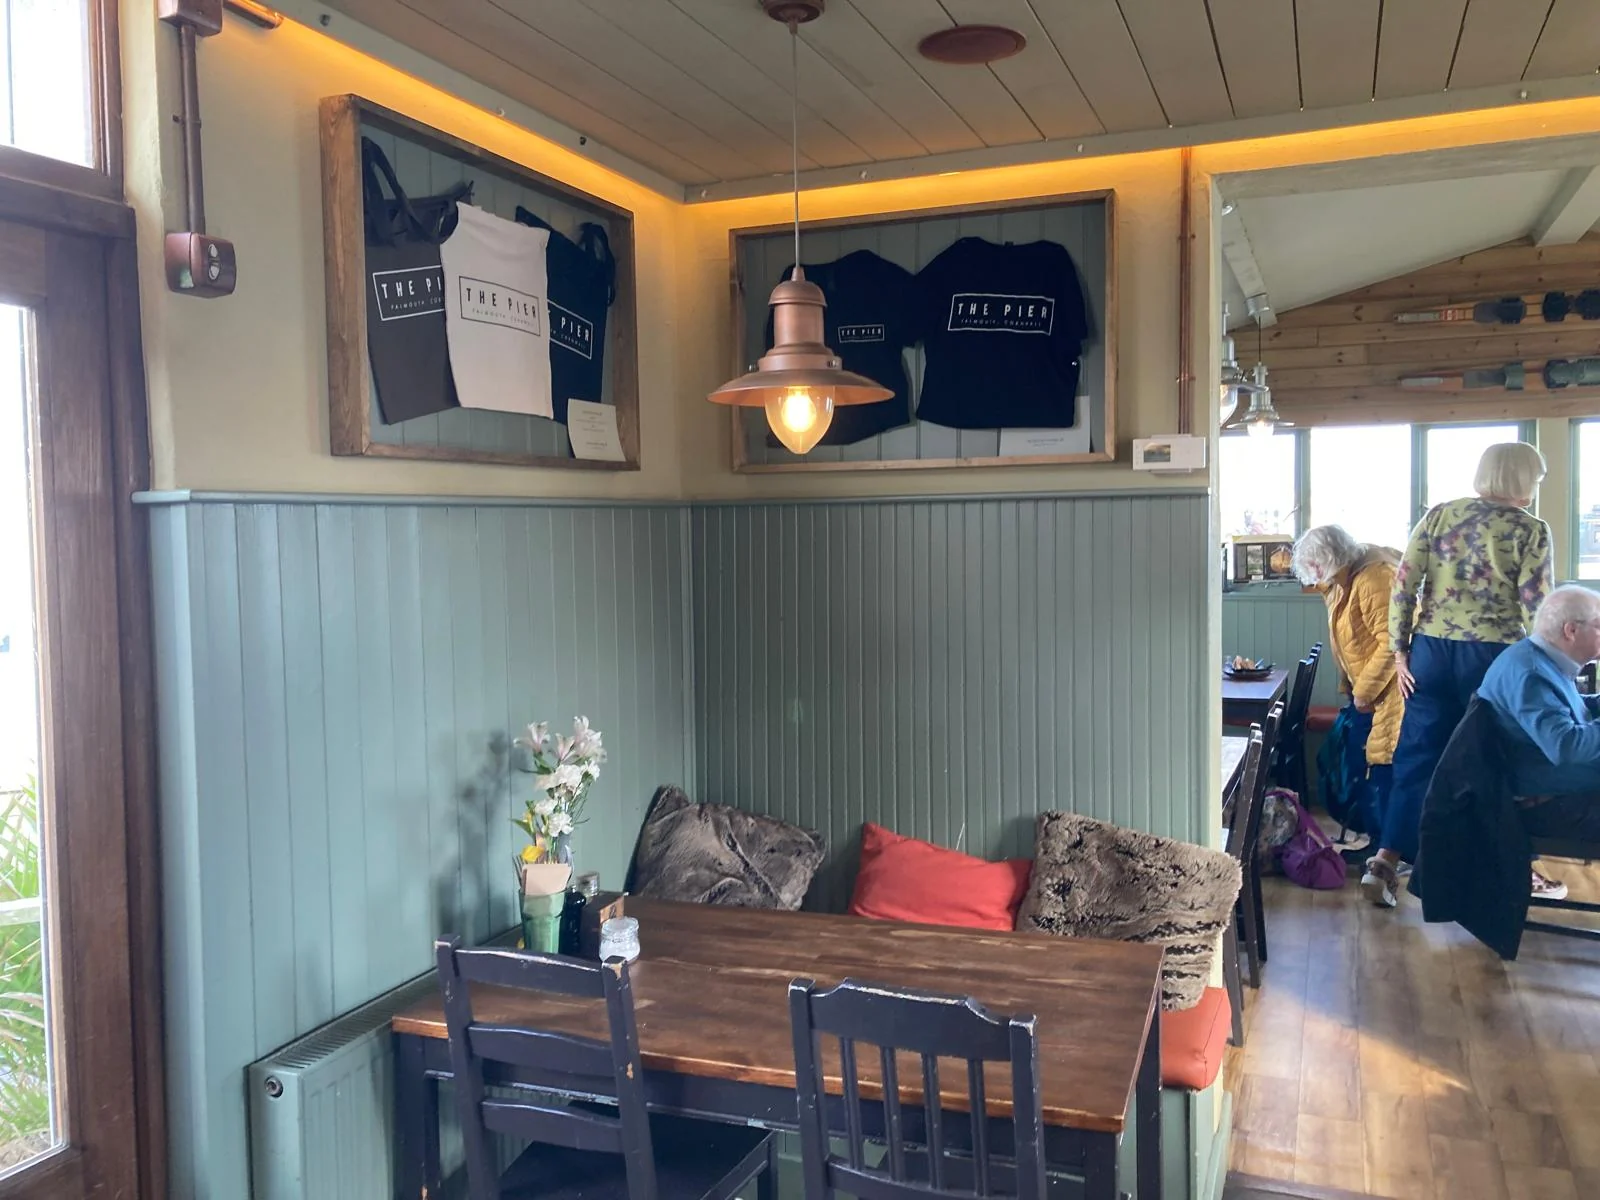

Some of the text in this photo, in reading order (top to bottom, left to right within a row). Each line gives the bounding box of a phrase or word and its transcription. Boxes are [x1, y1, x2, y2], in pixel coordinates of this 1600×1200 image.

[381, 276, 442, 299] THE PI
[466, 287, 497, 307] THE
[507, 297, 537, 319] PIER
[958, 303, 1048, 319] THE PIER
[561, 316, 590, 342] PIER
[861, 327, 882, 335] PIER
